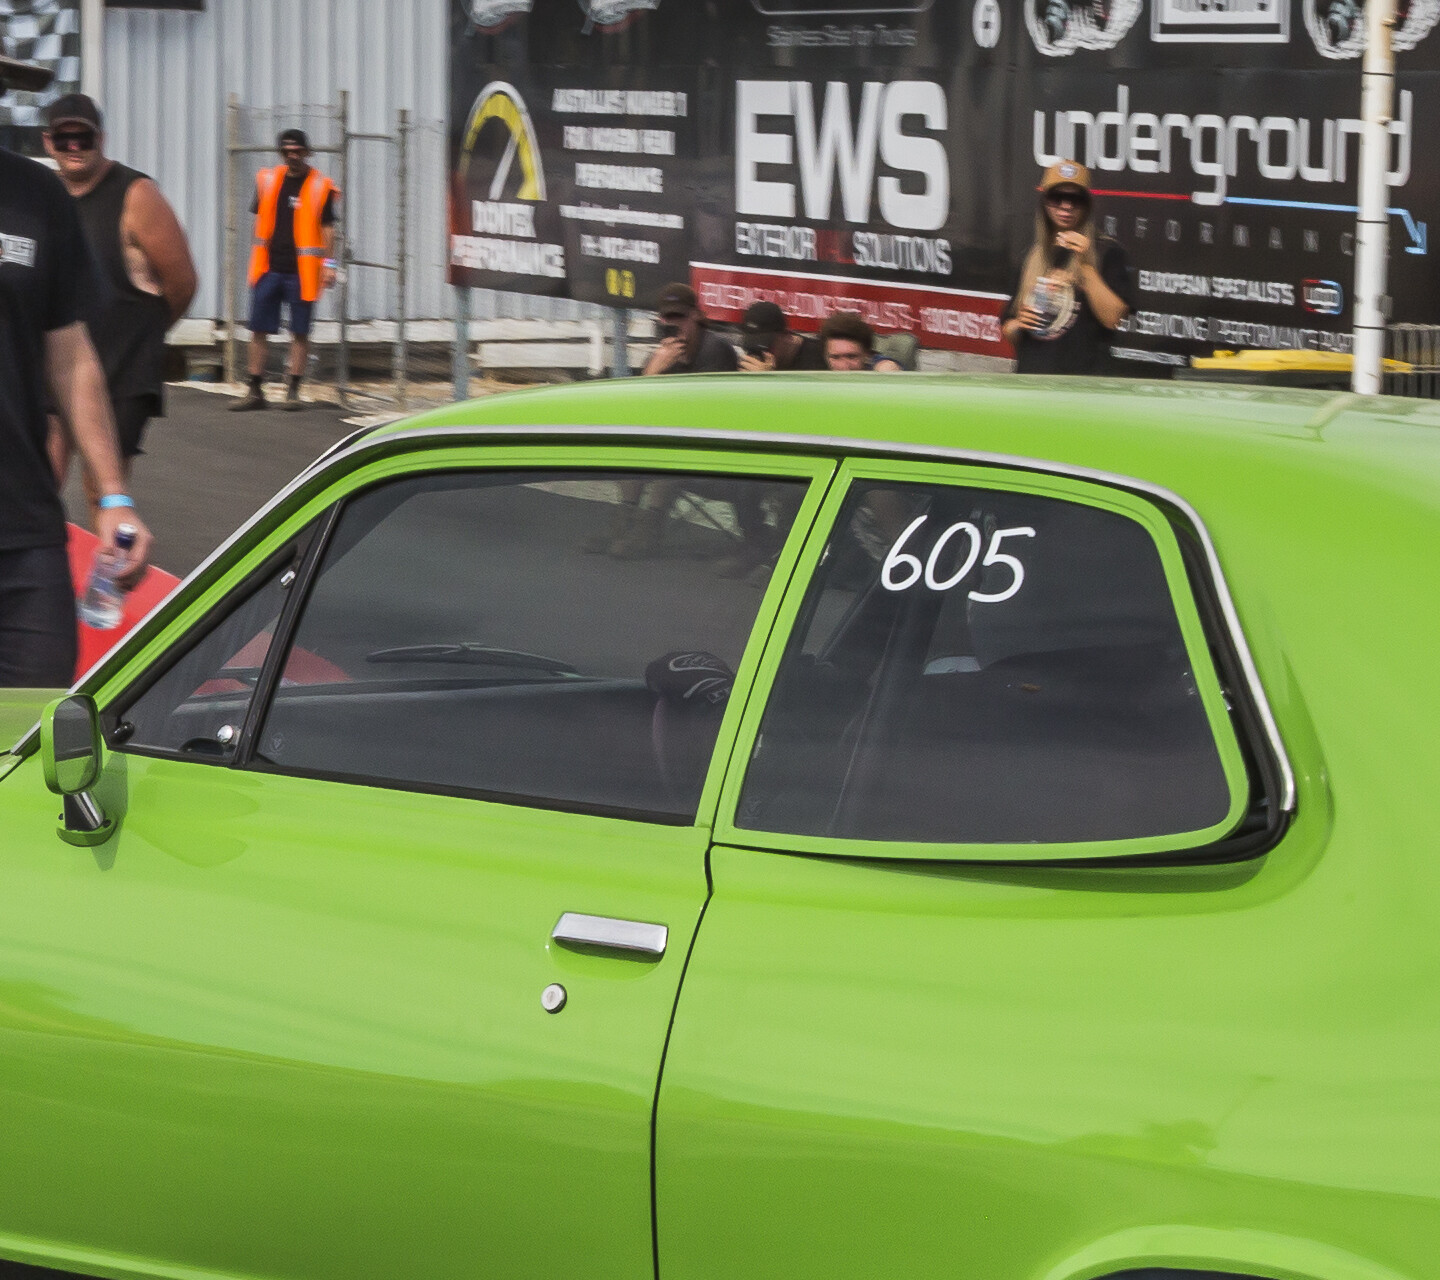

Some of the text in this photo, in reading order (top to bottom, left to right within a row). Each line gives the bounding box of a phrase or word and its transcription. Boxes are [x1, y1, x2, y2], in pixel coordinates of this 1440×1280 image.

[735, 79, 950, 231] EWS
[1033, 84, 1413, 206] underground
[734, 221, 818, 261] EXTERIOR
[852, 230, 953, 275] SOLUTIONS
[1138, 269, 1296, 306] EUROPEAN SPECIALISTS
[880, 513, 1037, 604] 605
